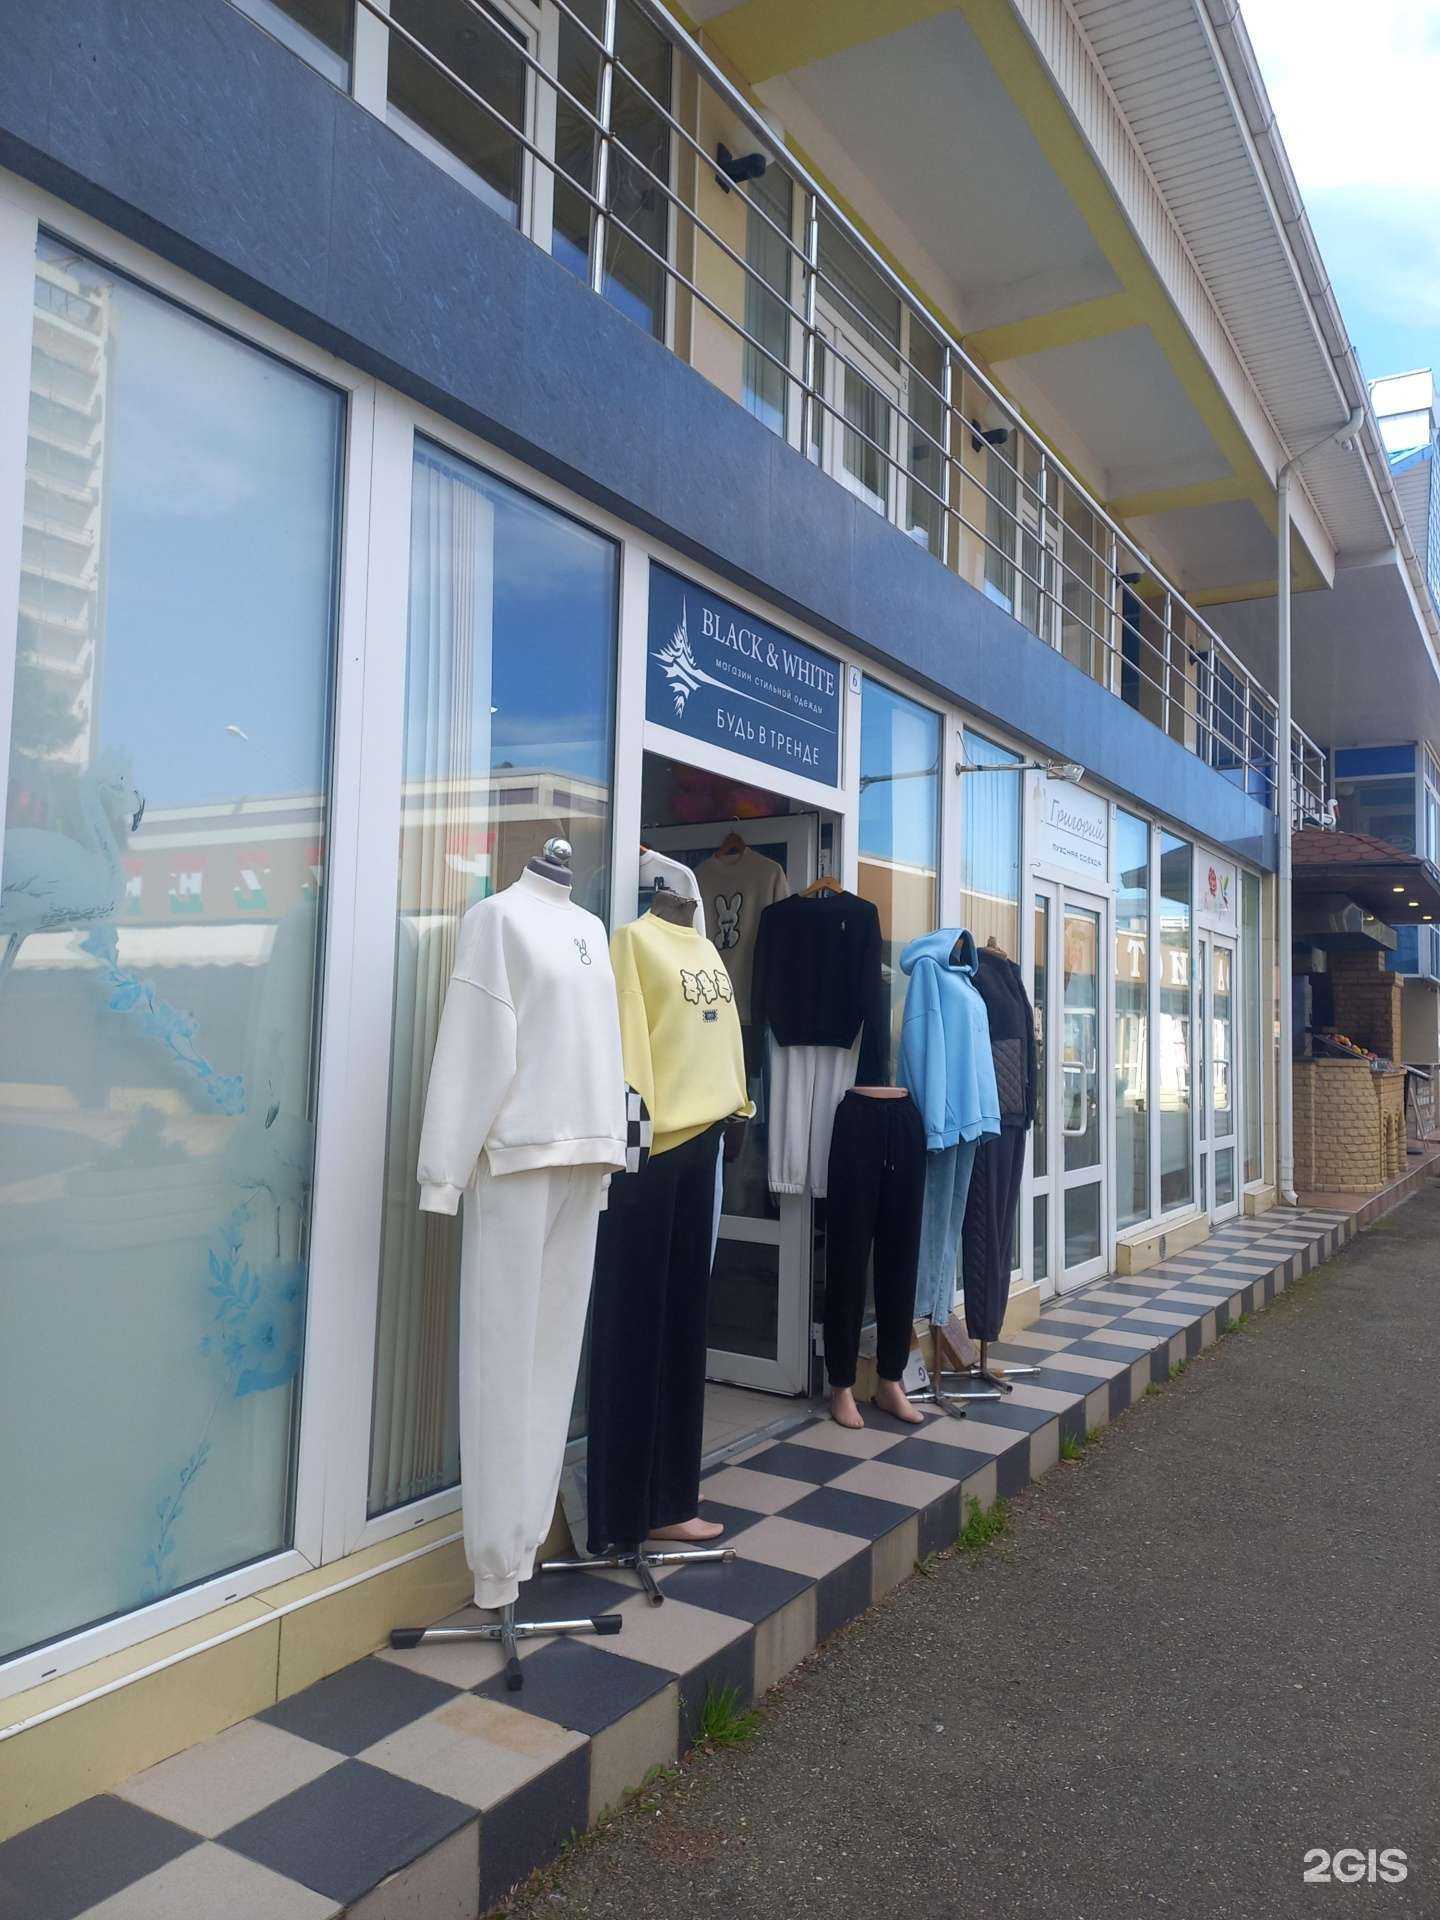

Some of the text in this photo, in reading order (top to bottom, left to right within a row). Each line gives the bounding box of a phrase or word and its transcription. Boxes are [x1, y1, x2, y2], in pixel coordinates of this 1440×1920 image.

[702, 607, 835, 697] BLACK & WHITE
[717, 708, 820, 766] БУДЬ В ТРЕНДЕ
